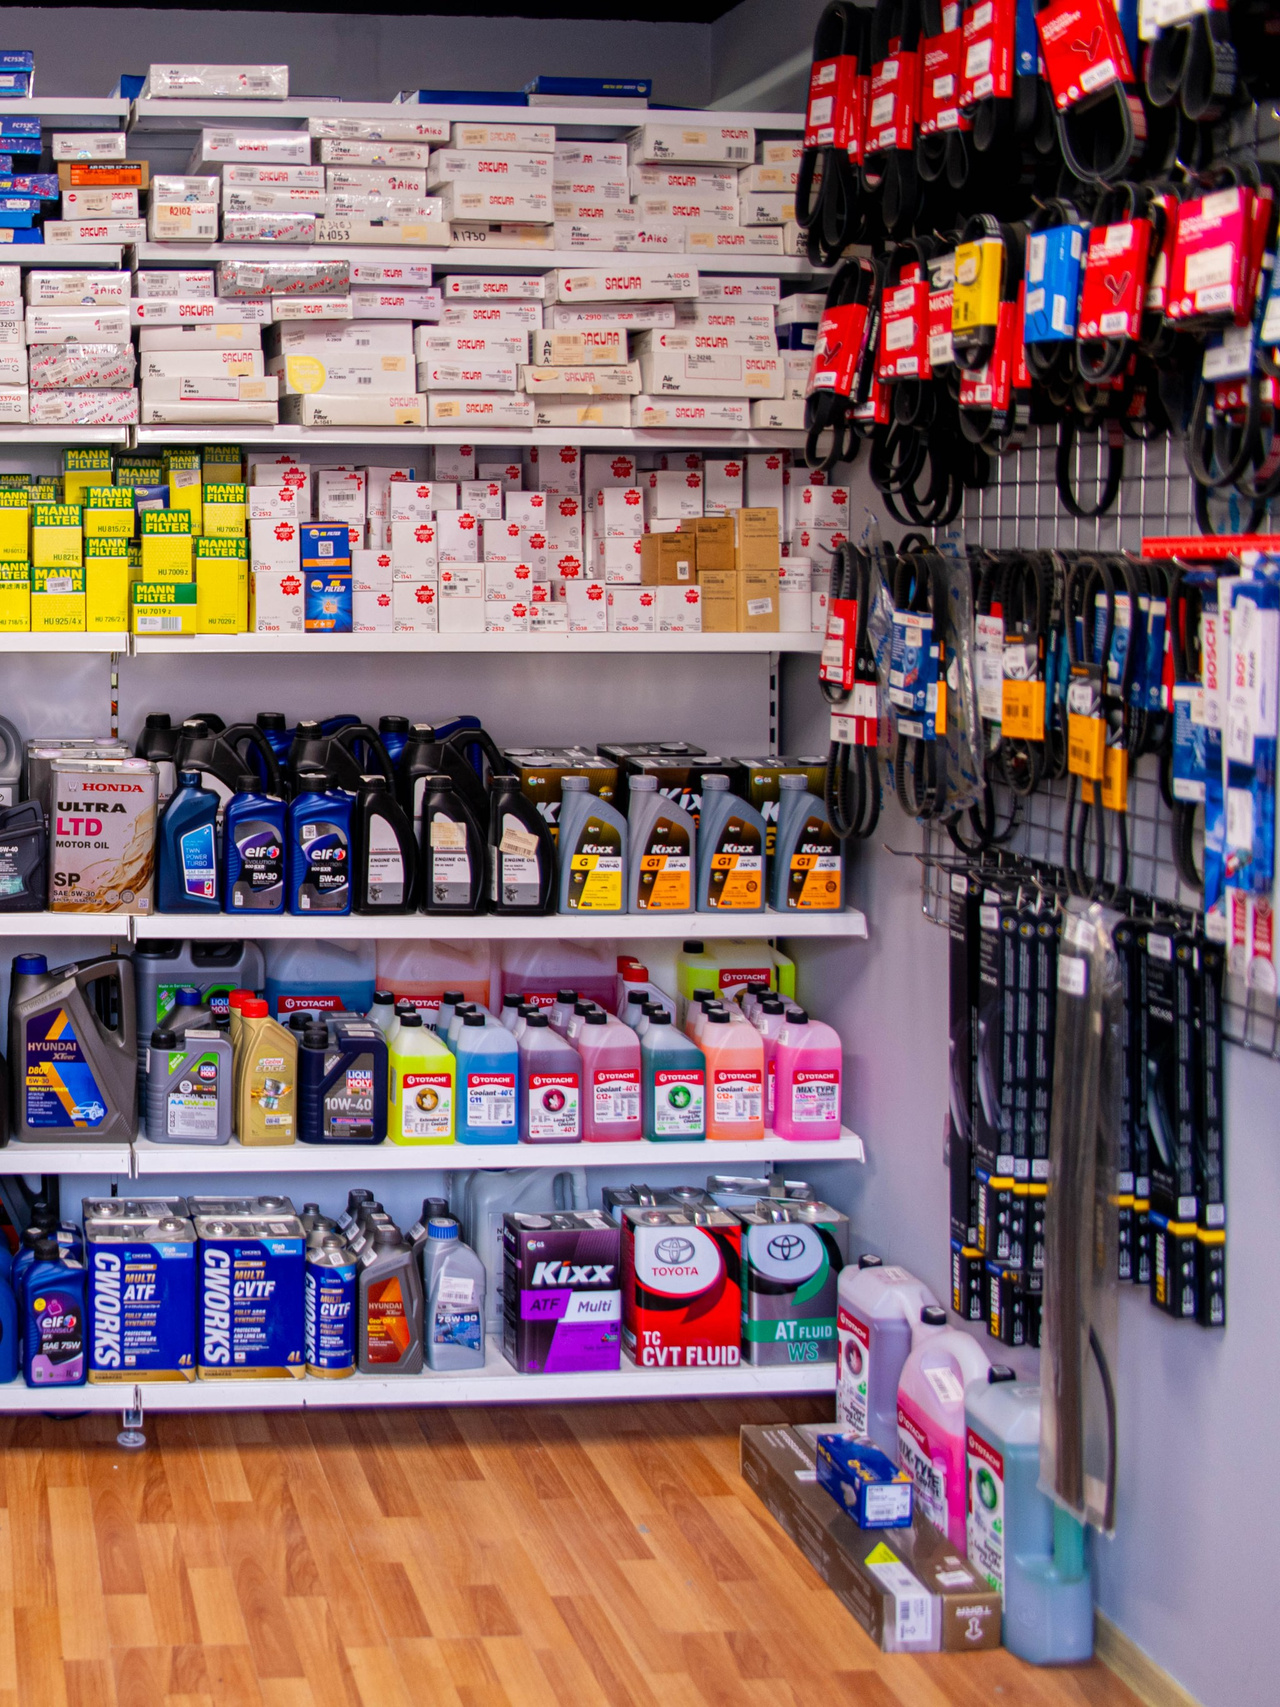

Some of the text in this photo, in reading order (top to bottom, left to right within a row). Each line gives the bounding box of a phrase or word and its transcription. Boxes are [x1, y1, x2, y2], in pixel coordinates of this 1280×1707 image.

[721, 129, 749, 139] SAKURA
[259, 171, 288, 182] SAKURA
[668, 176, 696, 186] SAKURA
[462, 231, 486, 242] 1730
[179, 306, 214, 316] SAKURA
[457, 340, 485, 349] SAKURA
[695, 336, 728, 348] SAKURA
[746, 359, 776, 370] SAKURA
[675, 408, 705, 418] SAKURA
[68, 450, 108, 460] MANN
[68, 460, 109, 469] FILTER
[90, 488, 132, 498] MANN
[90, 498, 132, 508] FILTER
[146, 513, 188, 523] MANN
[146, 522, 189, 533] FILTER
[1206, 619, 1217, 690] BOSCH
[82, 783, 144, 793] HONDA
[57, 802, 127, 813] ULTRA
[56, 818, 102, 836] LTD
[56, 841, 109, 849] MOTOR OIL
[582, 844, 614, 853] Kixx
[651, 844, 682, 853] Kixx
[722, 843, 753, 853] Kixx
[245, 847, 265, 858] elf
[311, 849, 332, 860] elf
[647, 858, 661, 867] G1
[54, 873, 80, 887] SP
[253, 872, 278, 881] 5W-30
[319, 874, 345, 883] 5W-40
[28, 1042, 76, 1051] HYUNDAI
[28, 1066, 49, 1075] D800
[348, 1071, 372, 1079] LIQUI
[348, 1079, 372, 1087] MOLY
[796, 1086, 836, 1094] MIX-TYPE
[324, 1098, 372, 1111] 10W-40
[234, 1270, 264, 1280] MULTI
[531, 1261, 615, 1285] Kixx
[652, 1267, 699, 1276] TOYOTA
[125, 1273, 155, 1283] MULTI
[123, 1285, 155, 1300] ATF
[233, 1281, 275, 1298] CVTF
[94, 1252, 121, 1367] CWORKS
[204, 1249, 230, 1364] CWORKS
[321, 1302, 350, 1316] CVTF
[369, 1302, 402, 1310] HYUNDAI
[530, 1299, 611, 1313] ATF Multi
[42, 1317, 64, 1328] elf
[775, 1321, 832, 1340] AT FLUID
[643, 1331, 661, 1345] TC
[43, 1341, 81, 1350] SAE 75W
[642, 1346, 739, 1366] CVT FLUID
[788, 1343, 818, 1362] WS
[178, 1354, 192, 1365] 4L
[904, 1416, 926, 1445] TOTACHI
[975, 1443, 1001, 1470] TOTACHI
